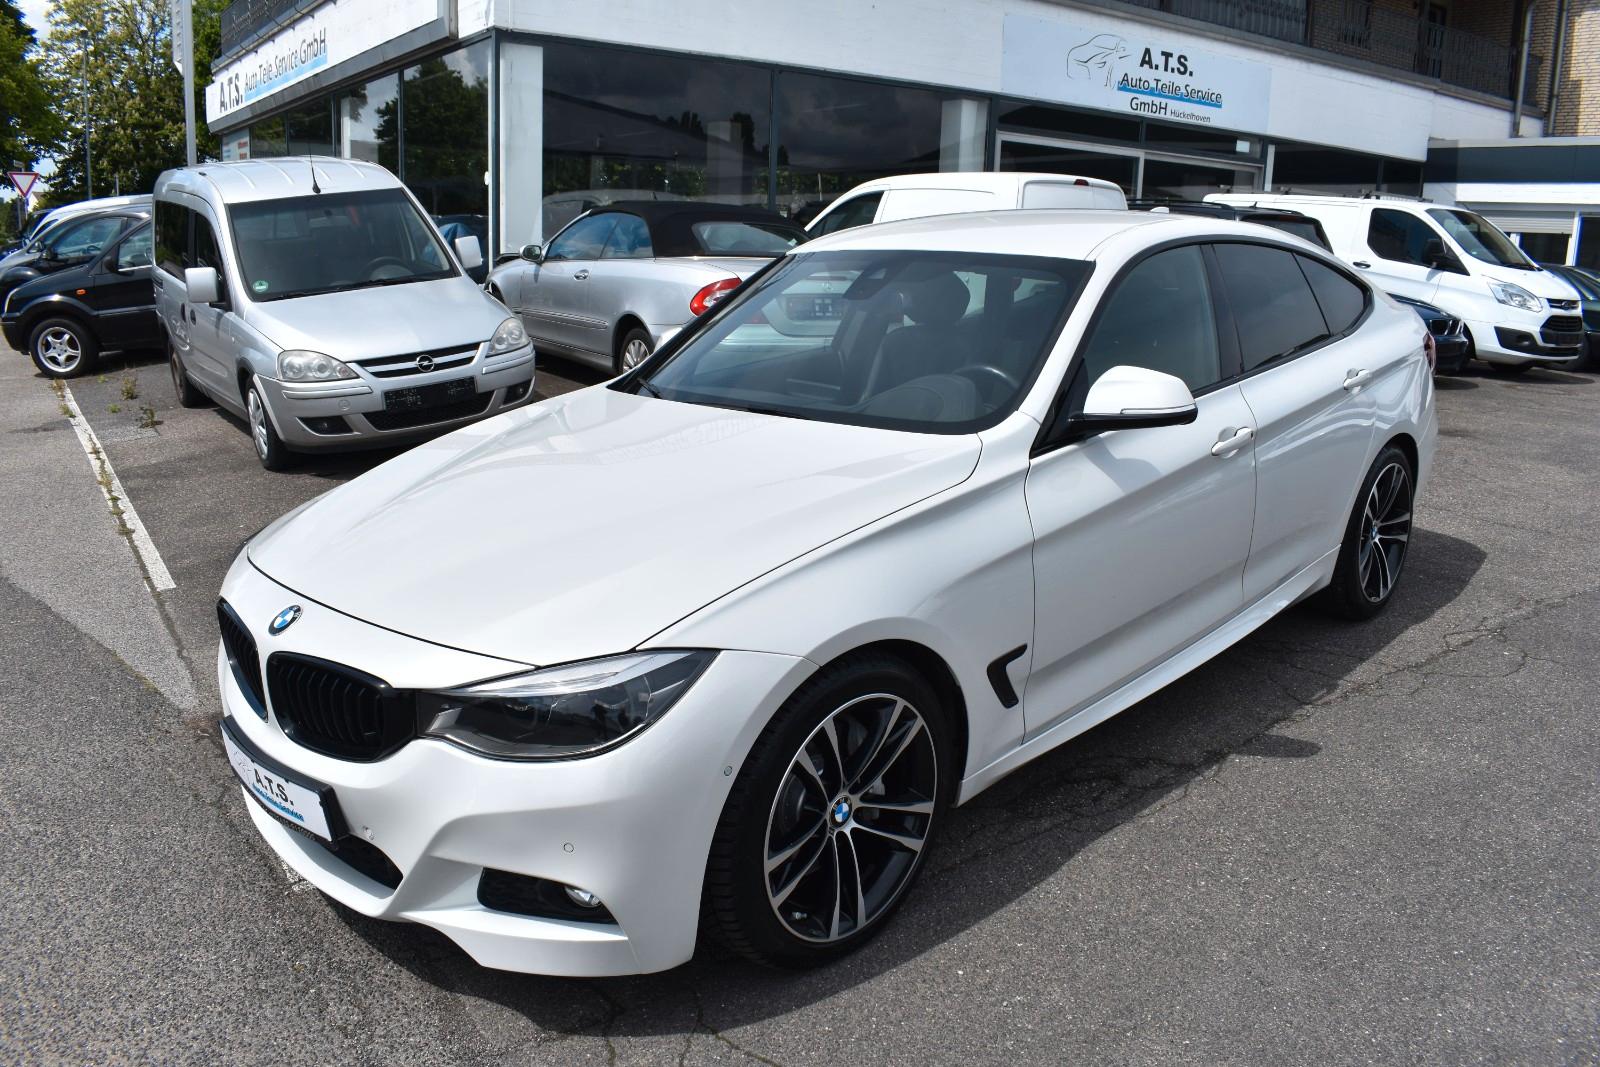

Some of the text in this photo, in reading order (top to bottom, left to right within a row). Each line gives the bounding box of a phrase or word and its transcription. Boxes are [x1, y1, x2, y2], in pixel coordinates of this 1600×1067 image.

[220, 72, 243, 113] A.T.S.
[275, 48, 298, 78] Service
[300, 27, 326, 65] GmbH
[1139, 47, 1194, 77] A.T.S.
[1119, 72, 1223, 104] Auto Teile Service
[1129, 97, 1168, 116] GmbH
[253, 767, 294, 806] A.T.S.
